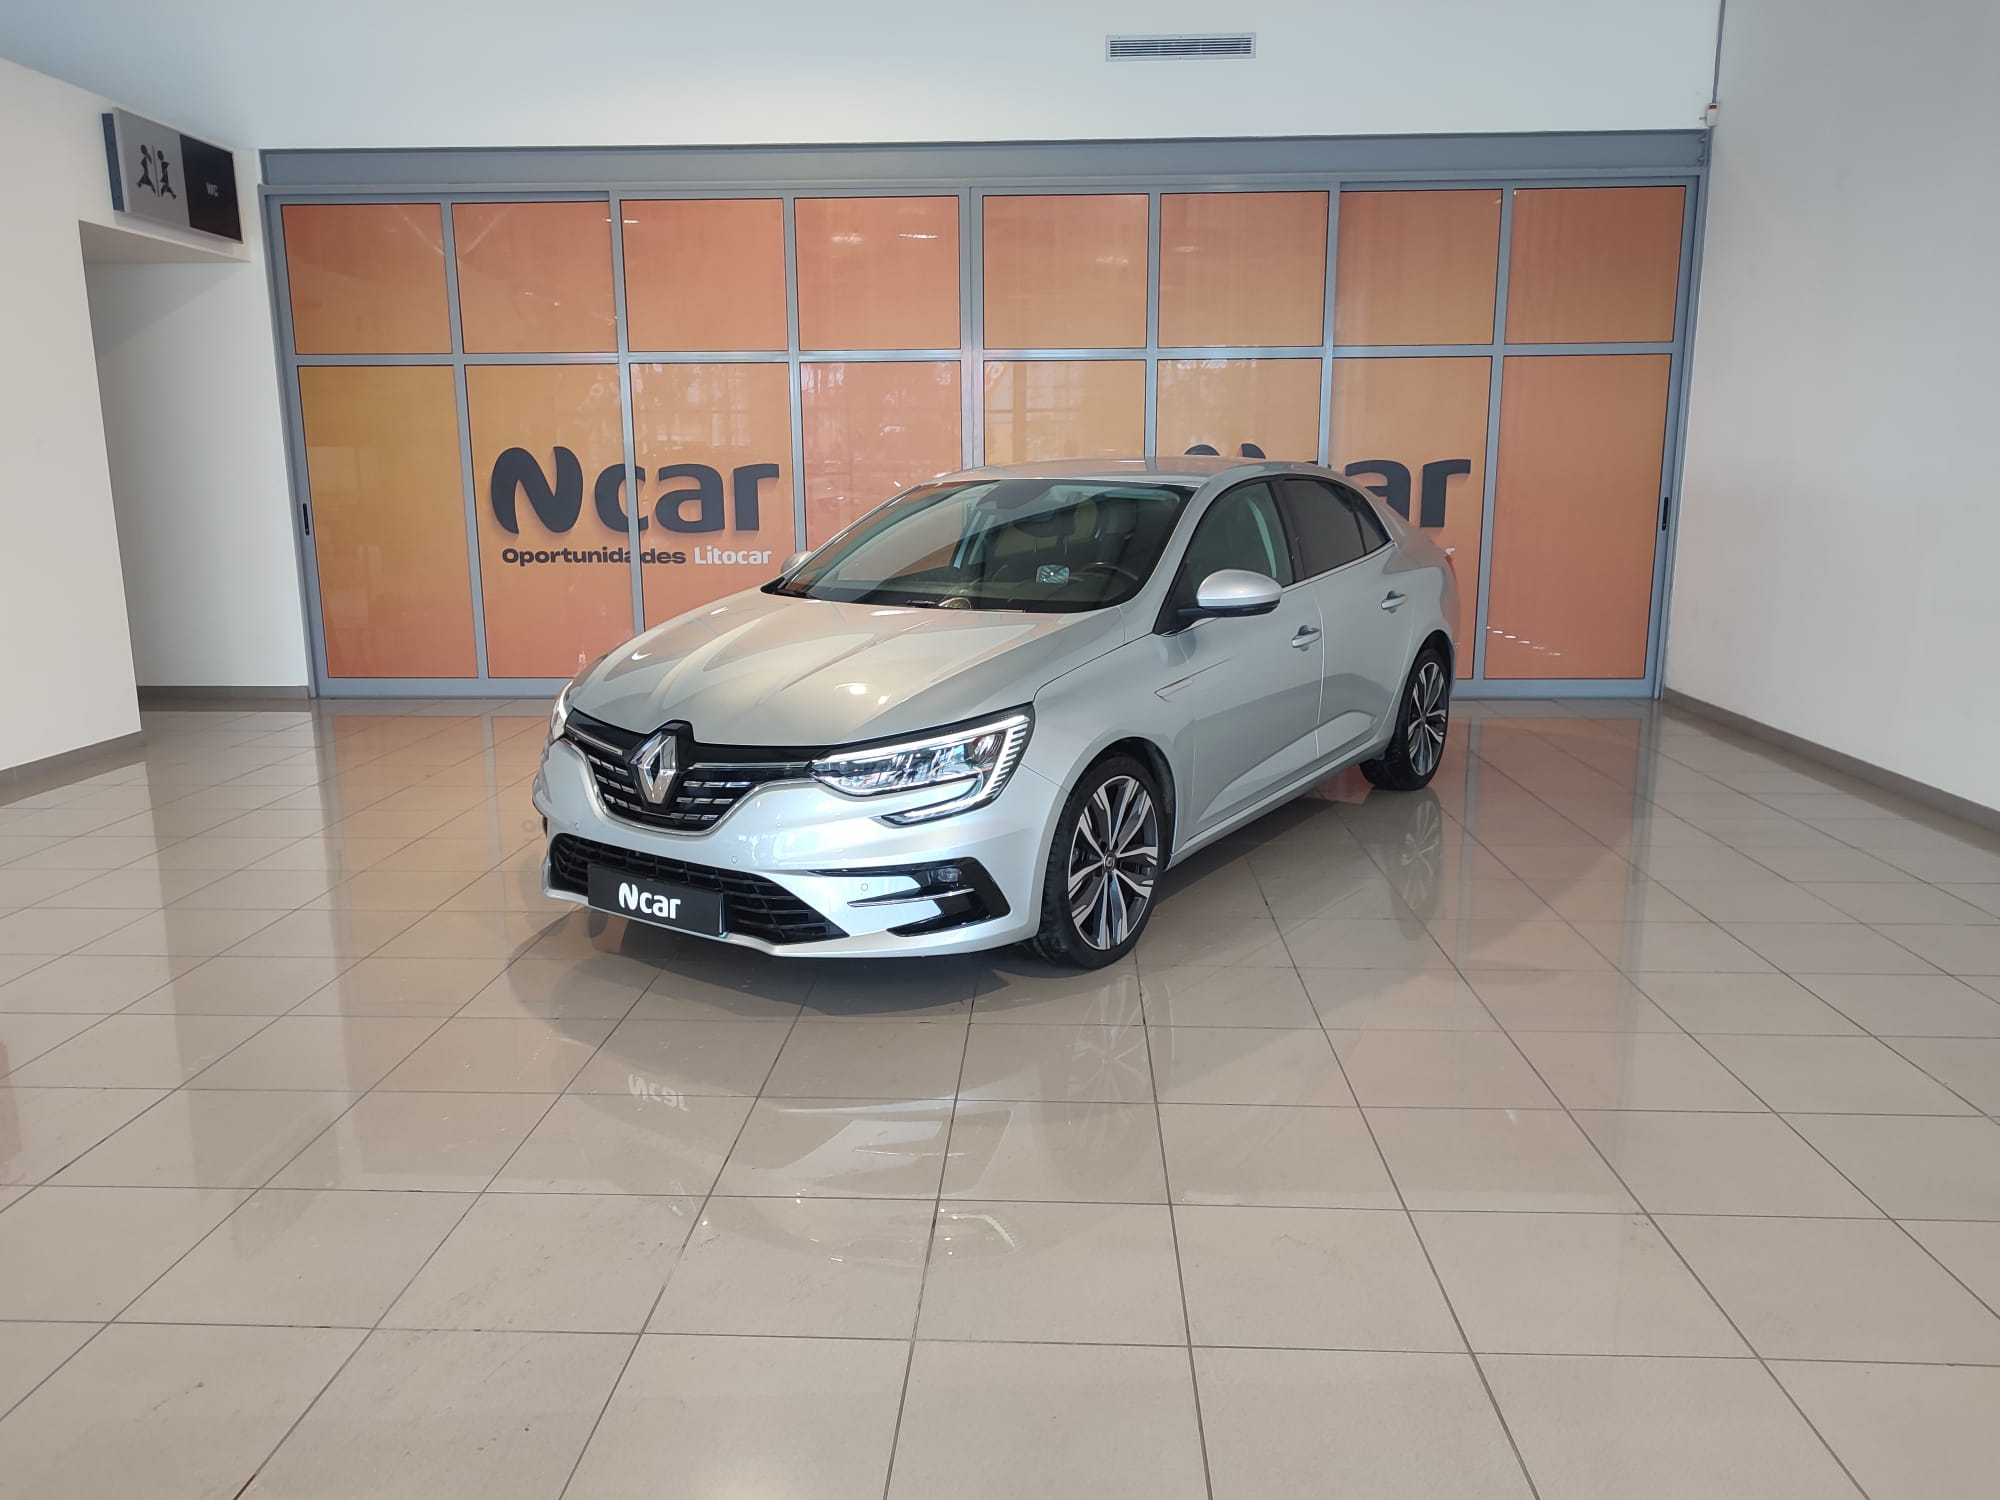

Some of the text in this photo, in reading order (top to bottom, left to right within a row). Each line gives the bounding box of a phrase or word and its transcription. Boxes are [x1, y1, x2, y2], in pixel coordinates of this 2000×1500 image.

[205, 182, 219, 197] WC
[491, 446, 779, 534] Ncar
[1184, 443, 1471, 528] ar
[694, 545, 772, 565] Litocar
[618, 882, 681, 919] Ncar
